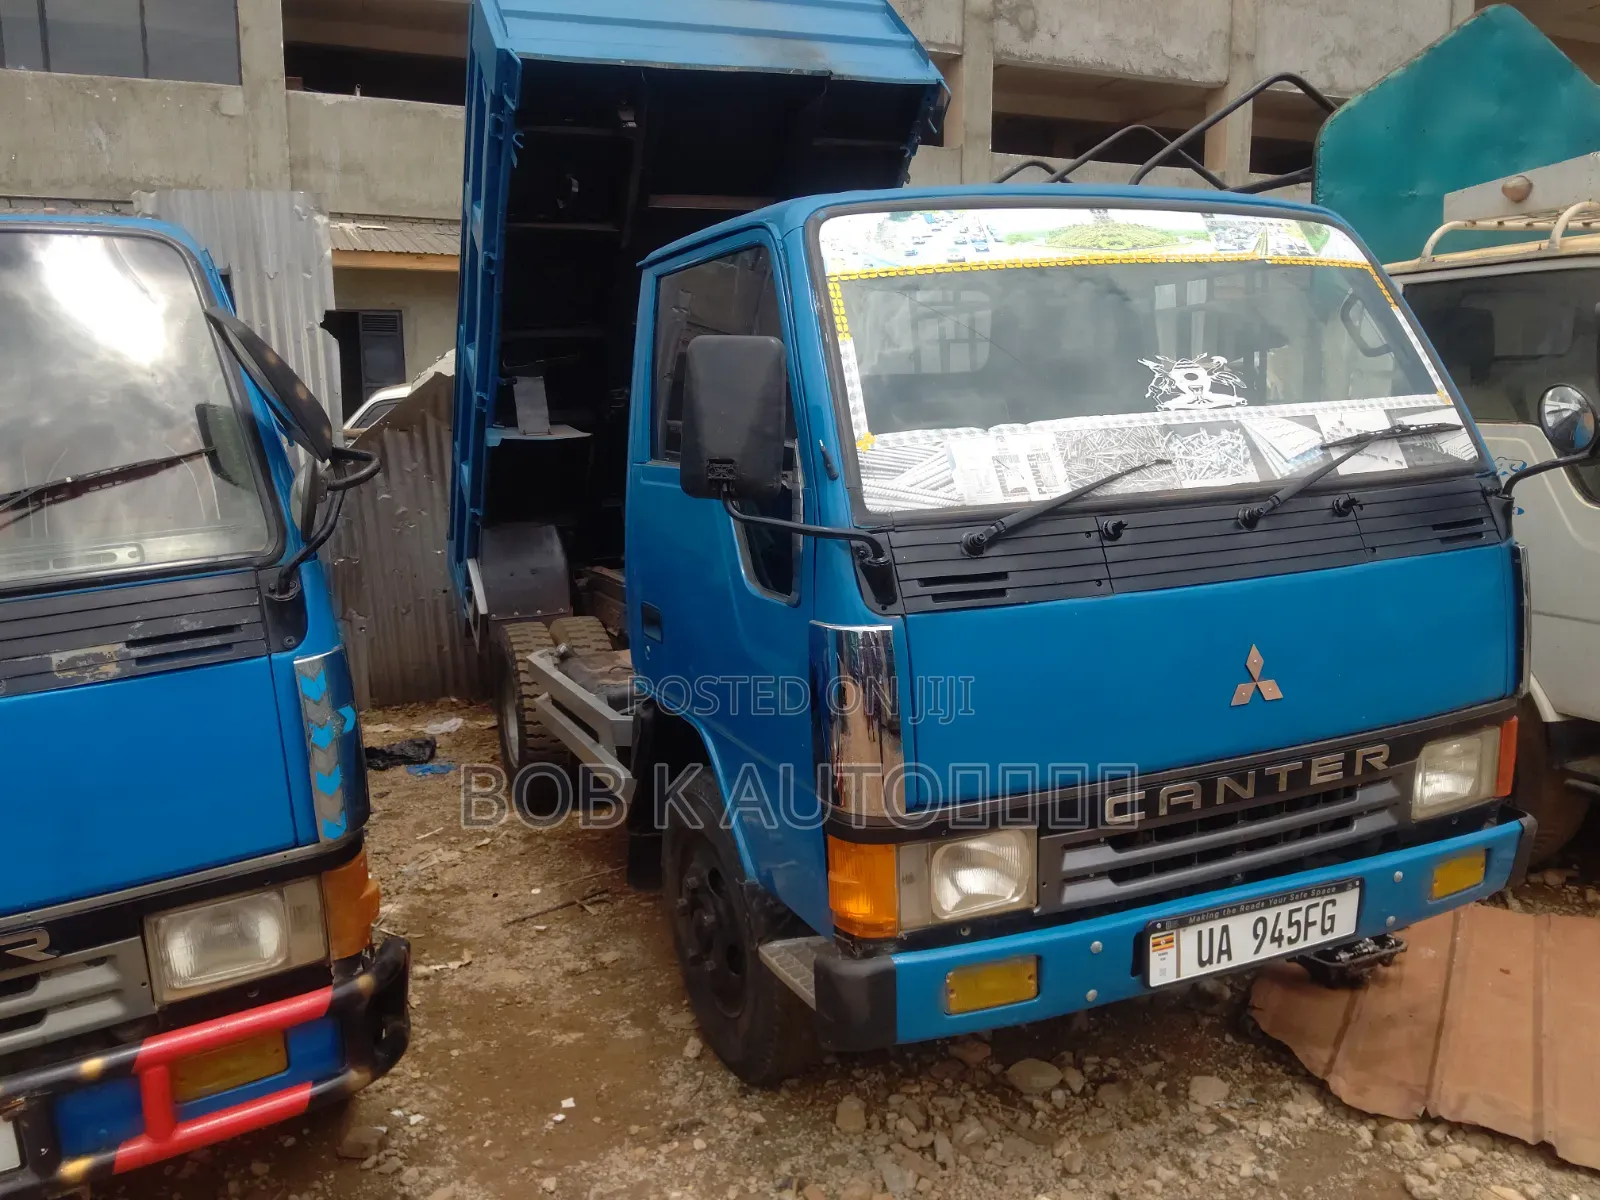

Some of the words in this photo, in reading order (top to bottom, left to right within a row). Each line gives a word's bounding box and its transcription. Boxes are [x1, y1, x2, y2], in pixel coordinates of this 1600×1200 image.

[1104, 743, 1391, 825] CANTER
[1269, 896, 1287, 906] Your
[1290, 890, 1308, 901] Safe
[1311, 886, 1337, 898] Space
[1197, 924, 1233, 969] UA
[1252, 898, 1338, 955] 945FG
